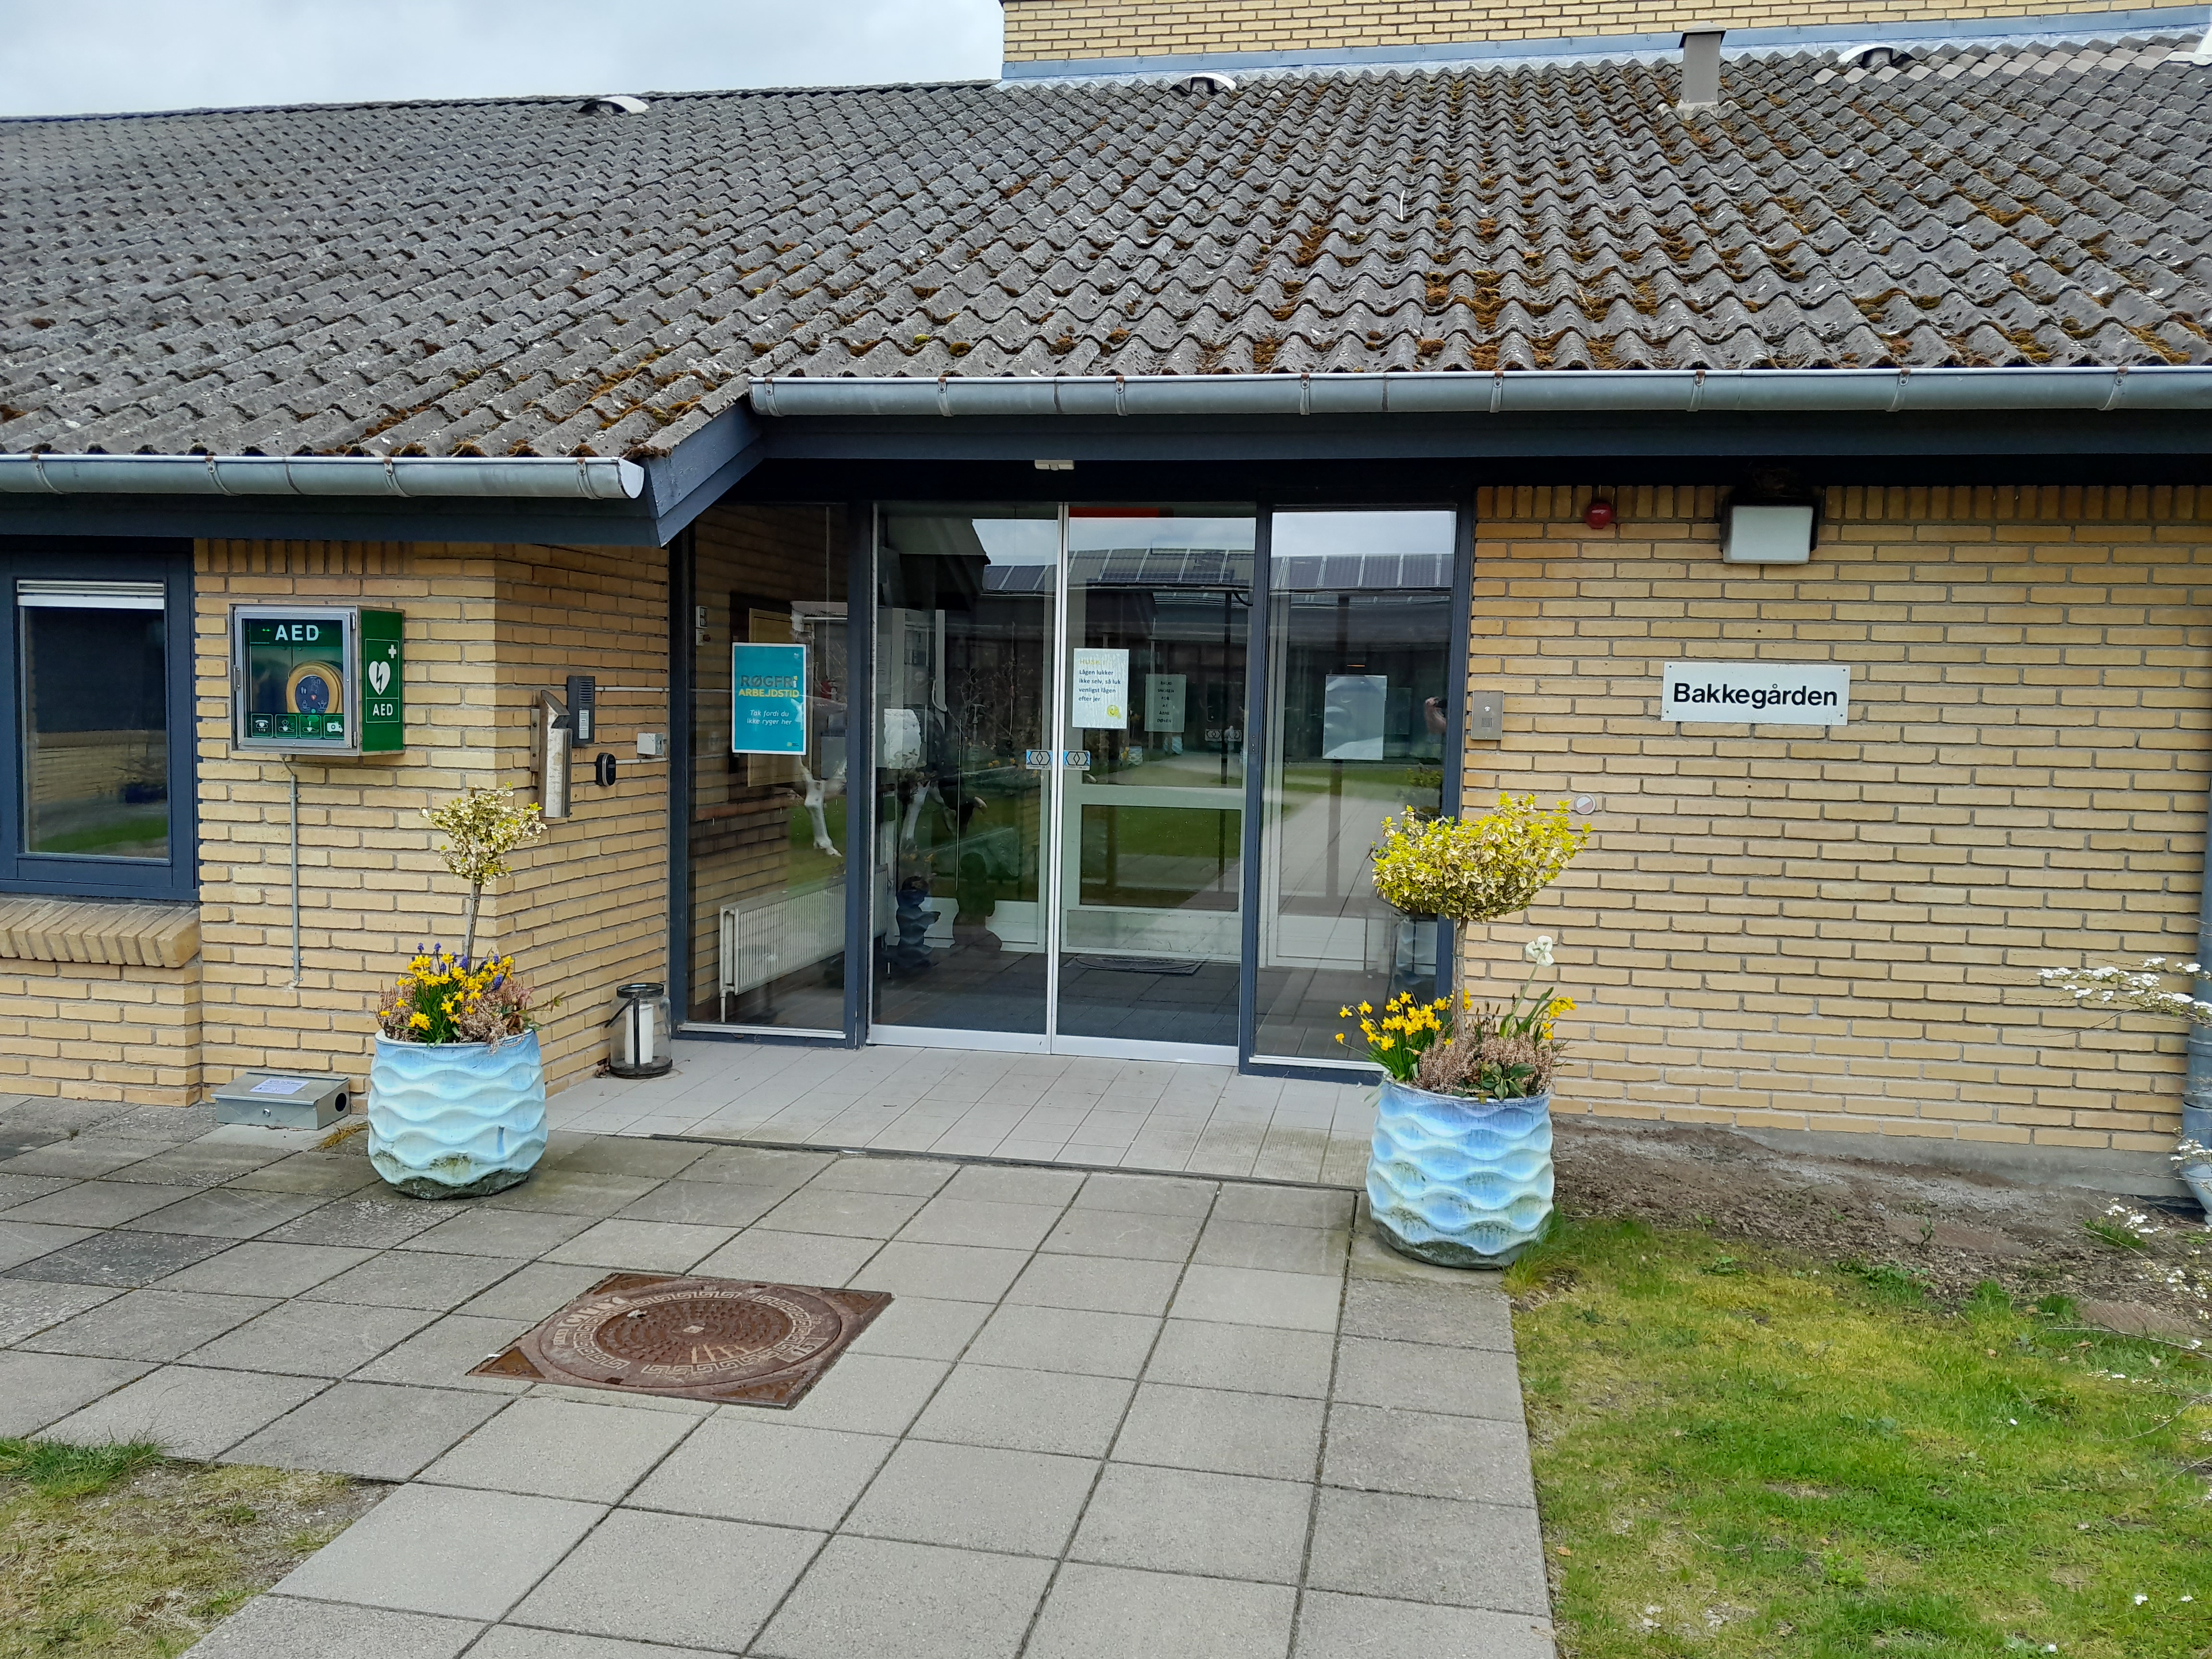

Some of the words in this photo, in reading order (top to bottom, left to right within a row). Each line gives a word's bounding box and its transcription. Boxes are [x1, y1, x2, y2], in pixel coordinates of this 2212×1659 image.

[275, 625, 320, 641] AED
[738, 688, 800, 697] ARBEJDSTID
[1673, 683, 1838, 709] Bakkegården
[372, 703, 394, 717] AED
